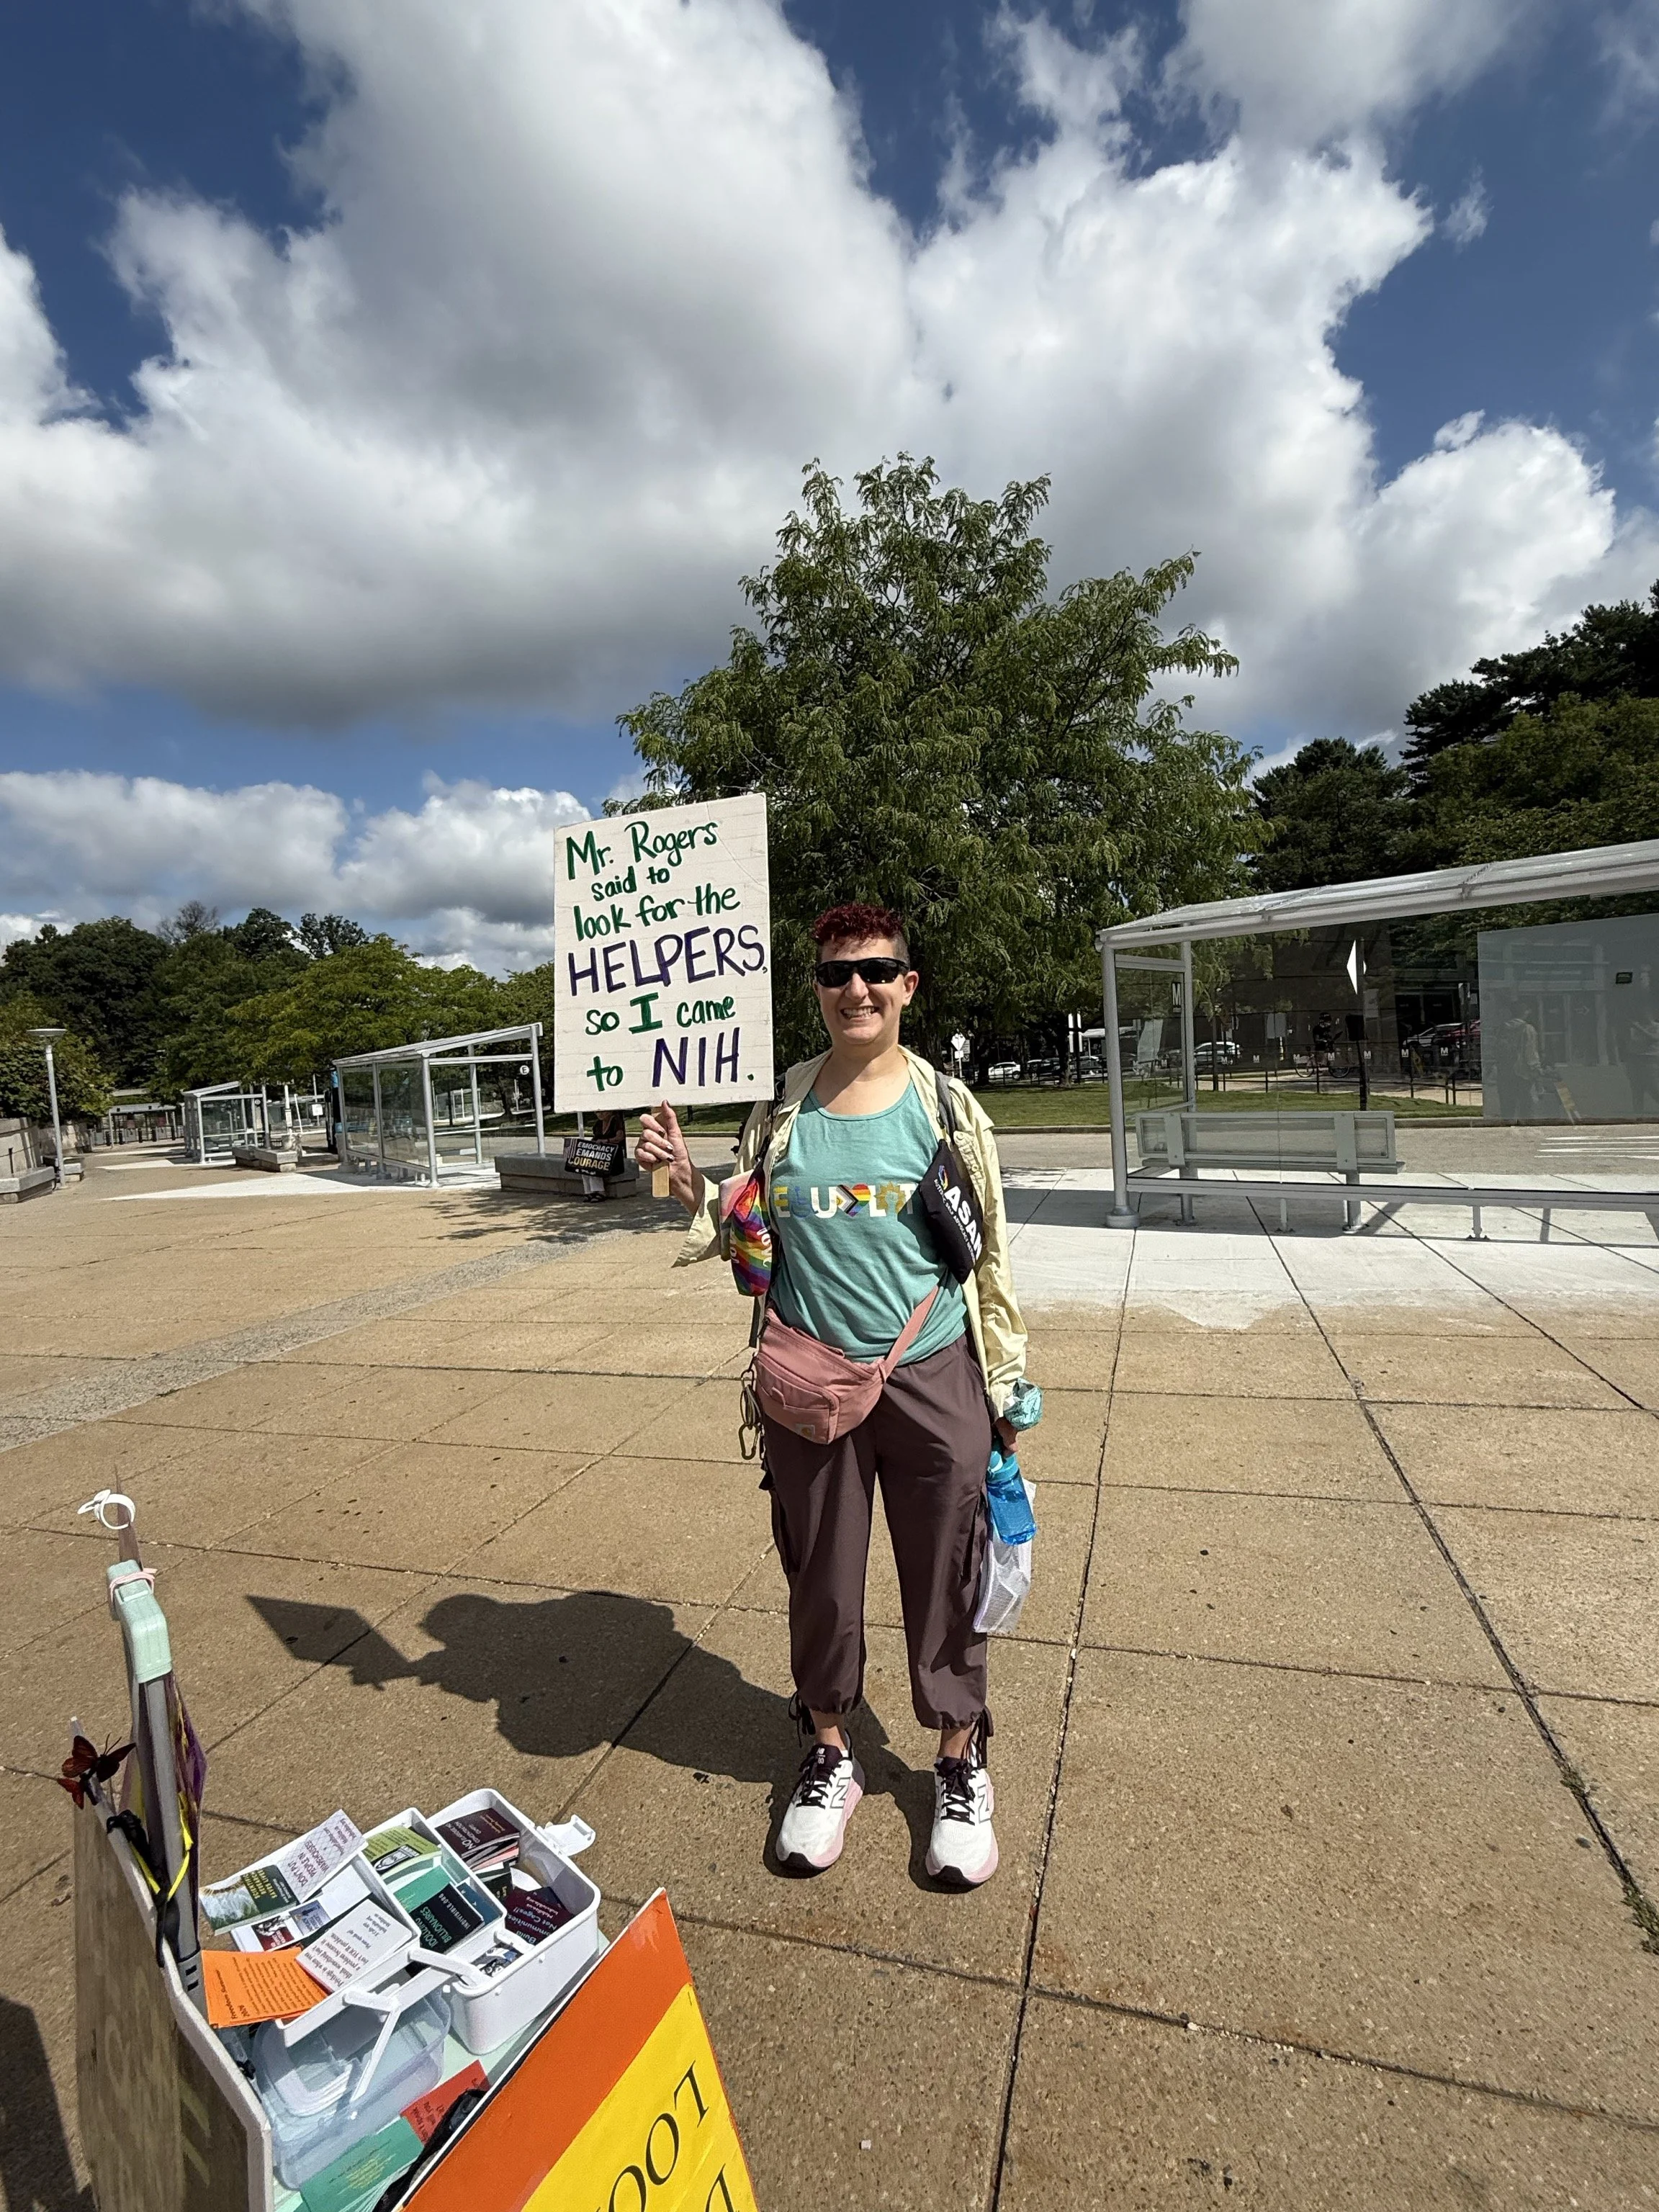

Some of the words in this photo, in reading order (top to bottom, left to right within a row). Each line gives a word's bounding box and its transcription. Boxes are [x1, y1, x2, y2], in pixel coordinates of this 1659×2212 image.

[567, 831, 614, 881] Mr.
[624, 821, 718, 866] Rogers
[591, 866, 637, 902] said
[646, 866, 670, 887] to
[574, 904, 631, 941] look
[636, 895, 684, 927] for
[687, 883, 740, 917] the
[567, 925, 768, 996] HELPERS,
[585, 1009, 619, 1035] so
[629, 992, 662, 1034] I
[676, 994, 736, 1028] came
[586, 1056, 623, 1092] to
[652, 1027, 754, 1088] NIH.
[576, 1148, 612, 1161] EMANDS
[577, 1141, 615, 1153] EMOCRACY
[241, 1872, 261, 1899] SCIENTIFIC
[300, 1856, 318, 1877] PEOPLE
[419, 1905, 452, 1944] BILLIONAIRES
[596, 2060, 709, 2212] LOO
